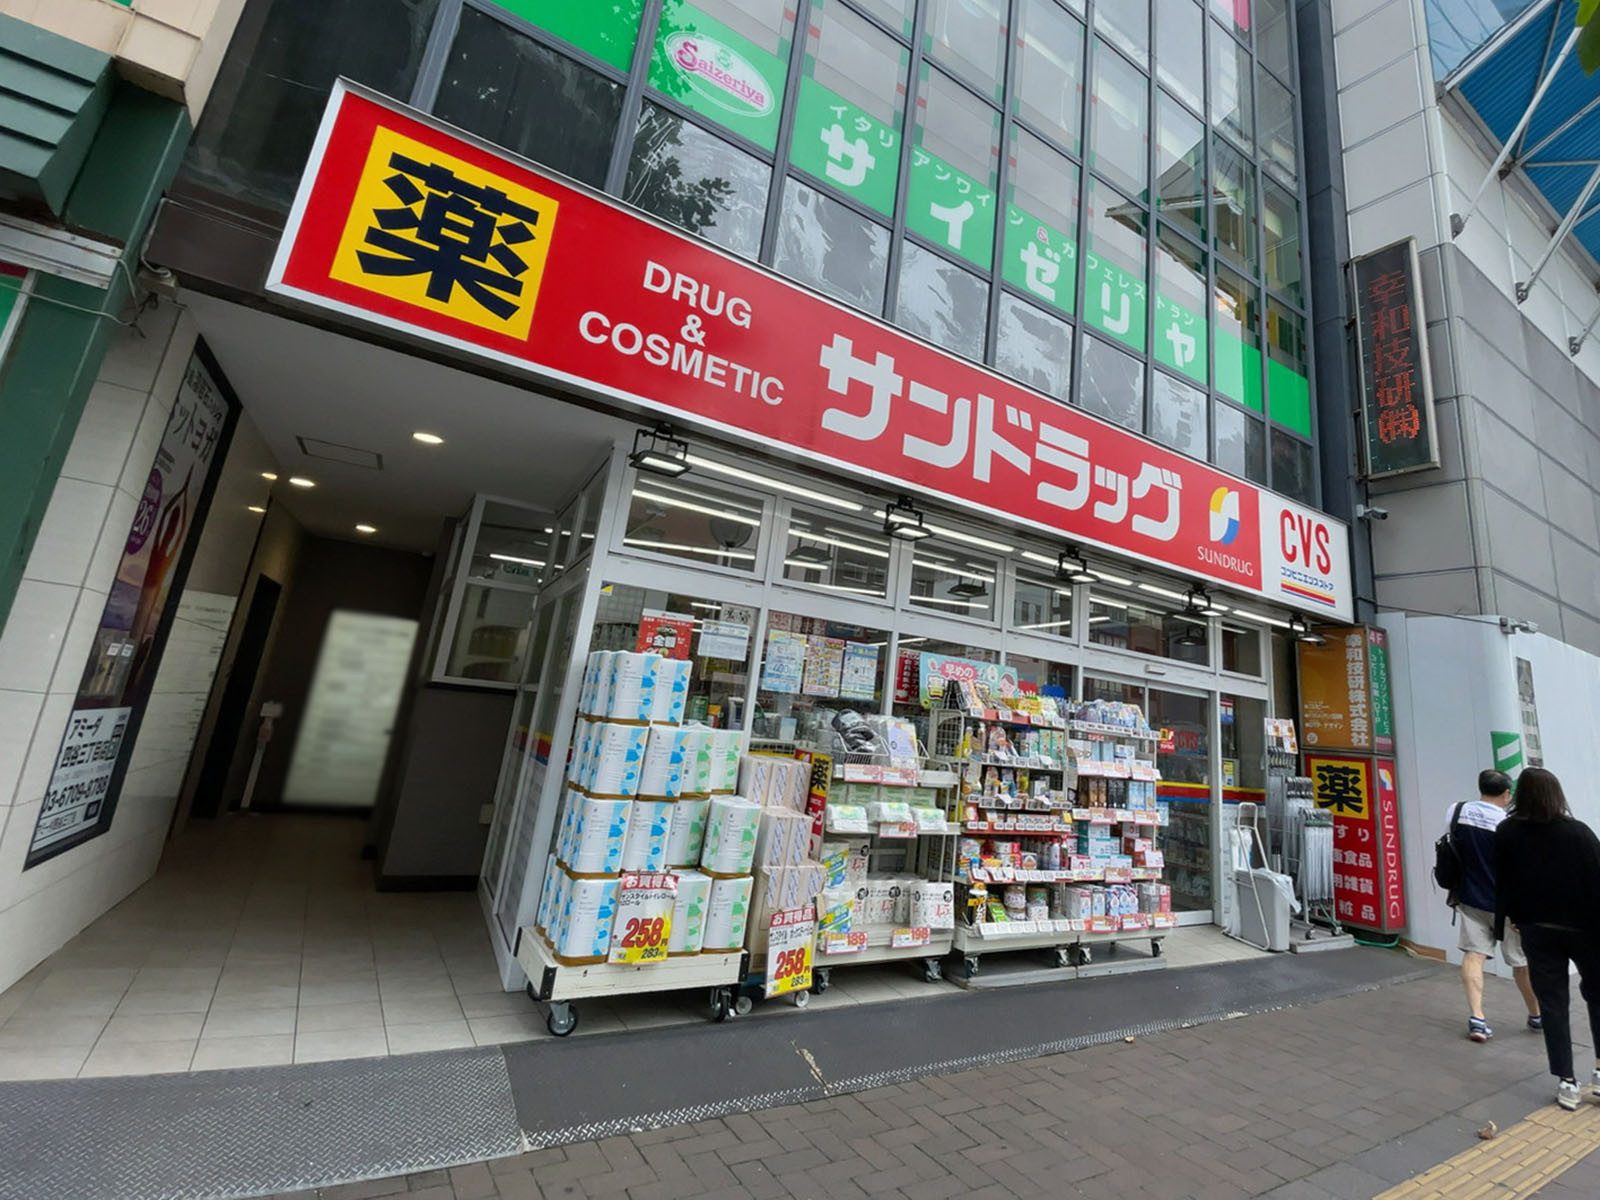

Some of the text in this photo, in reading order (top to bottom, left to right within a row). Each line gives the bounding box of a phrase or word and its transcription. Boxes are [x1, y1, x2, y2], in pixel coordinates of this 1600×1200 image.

[674, 41, 765, 106] Saizeriya
[355, 151, 540, 321] 薬
[820, 123, 1196, 369] サイゼリヤ
[643, 260, 752, 329] DRUG
[579, 311, 785, 406] COSMETIC
[680, 314, 706, 347] &
[819, 333, 1183, 541] サンドラッグ
[1197, 546, 1254, 576] SUNDRUG
[1280, 509, 1331, 575] CVS
[1316, 764, 1363, 813] 薬
[1383, 800, 1400, 919] SUNDRUG
[772, 909, 814, 926] お買得品
